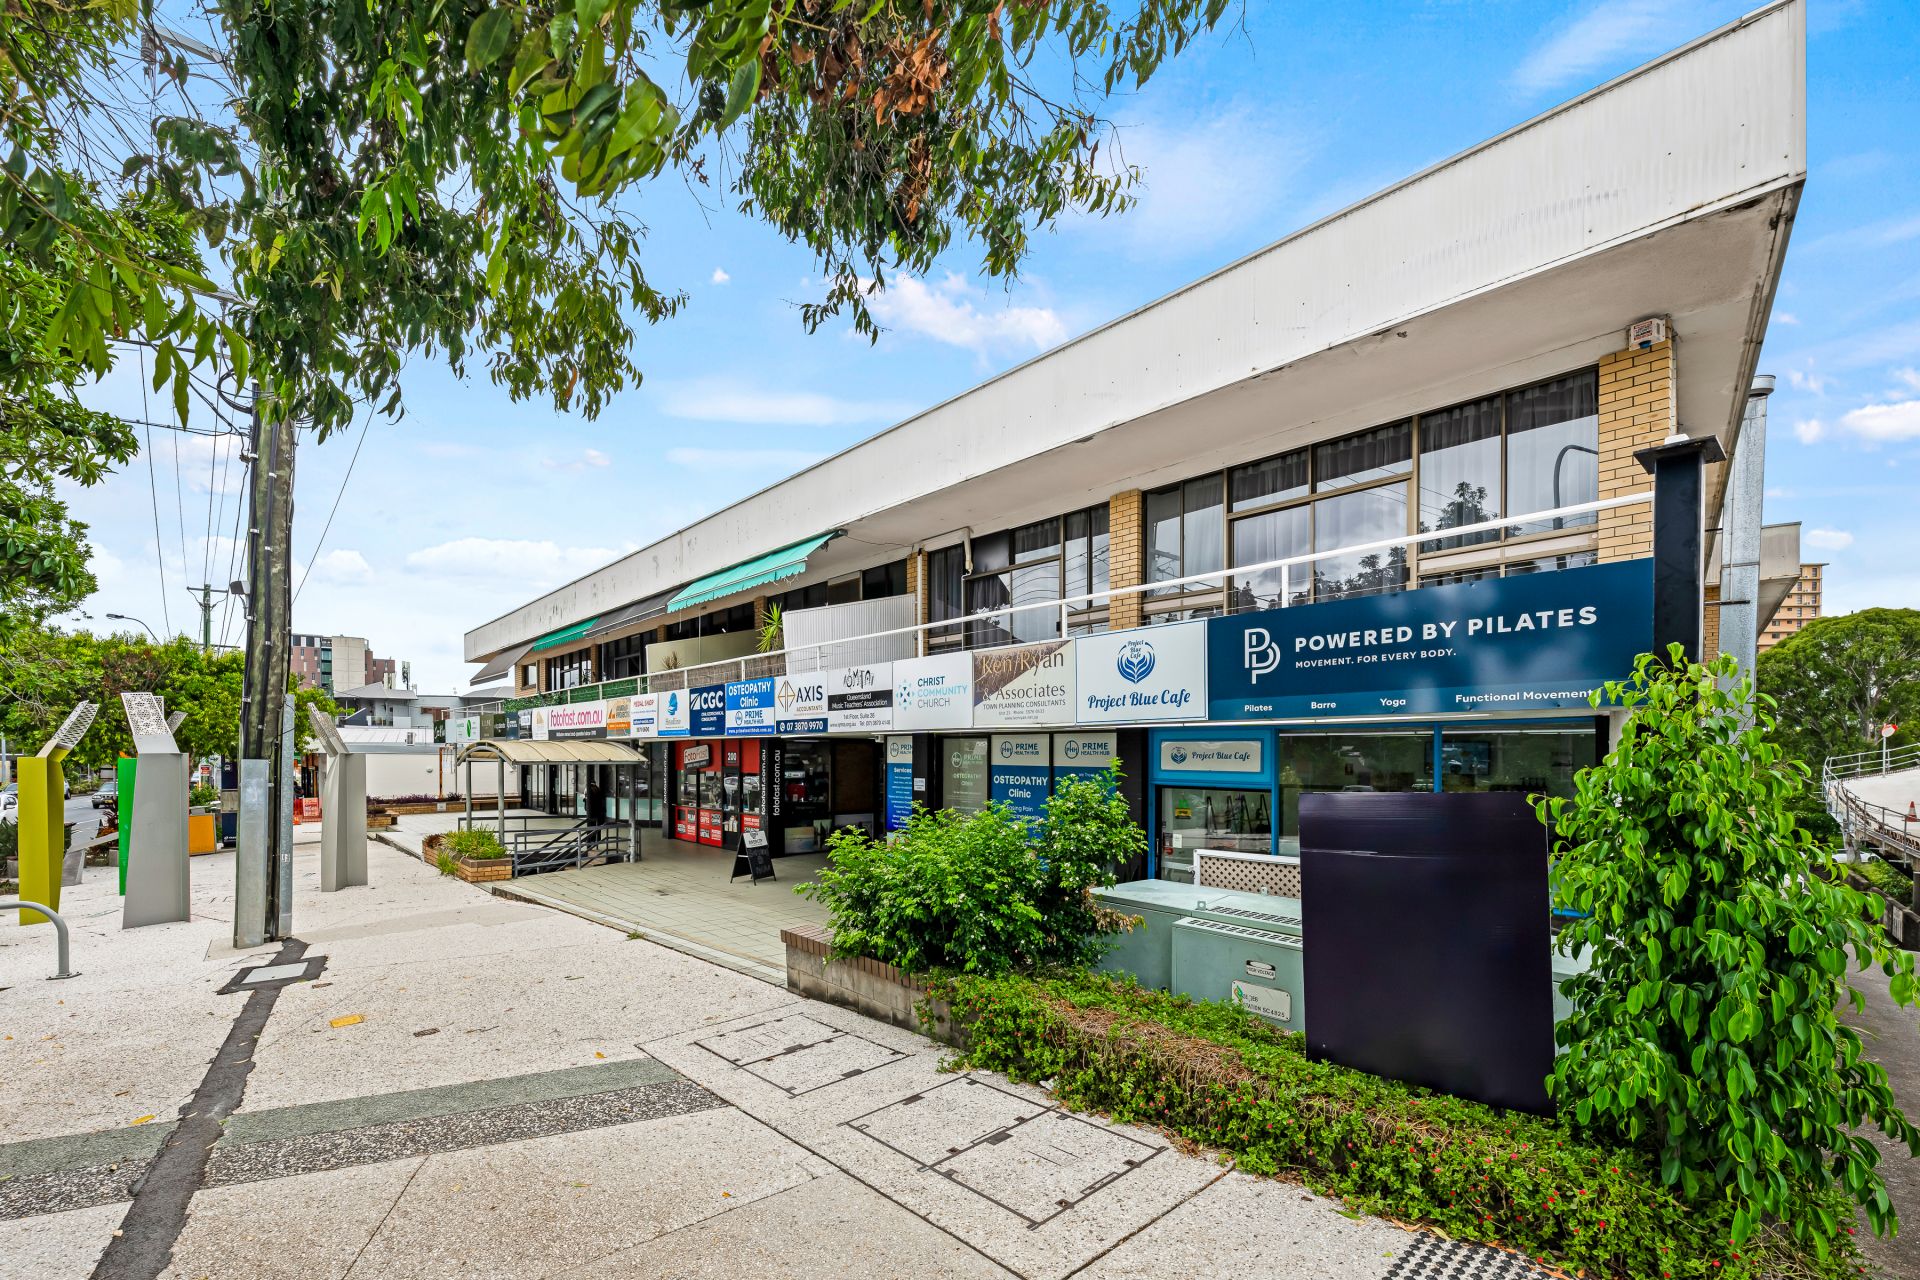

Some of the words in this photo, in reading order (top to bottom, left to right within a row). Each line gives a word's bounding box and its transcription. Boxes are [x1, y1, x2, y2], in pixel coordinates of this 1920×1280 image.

[1295, 627, 1413, 652] POWERED
[1422, 621, 1457, 641] BY
[1468, 606, 1598, 636] PILATES
[1127, 639, 1144, 648] Project
[982, 654, 1012, 675] Ken
[1020, 651, 1064, 676] Ryan
[1295, 656, 1354, 669] MOVEMENT.
[1357, 655, 1378, 664] FOR
[1381, 651, 1417, 662] EVERY
[1420, 648, 1457, 659] BODY.
[917, 675, 946, 687] CHRIST
[728, 681, 772, 696] OSTEOPATHY
[796, 684, 823, 703] AXIS
[917, 685, 968, 698] COMMUNITY
[982, 688, 991, 701] &
[995, 683, 1066, 701] Associates
[701, 691, 724, 709] CGC
[740, 695, 759, 707] Clinic
[846, 692, 872, 700] Queensland
[1087, 693, 1126, 711] Project
[1129, 691, 1159, 706] Blue
[1161, 688, 1191, 708] Cafe
[1455, 691, 1520, 703] Functional
[863, 699, 888, 707] Association
[917, 697, 951, 709] CHURCH
[983, 703, 998, 711] TOWN
[999, 701, 1025, 710] PLANNING
[1025, 699, 1066, 707] CONSULTANTS
[1244, 704, 1273, 712] Pilates
[1310, 701, 1337, 709] Barre
[1380, 698, 1406, 708] Yoga
[550, 708, 603, 727] fotofast.com.au
[744, 710, 763, 719] PRIME
[786, 722, 794, 731] 07
[808, 720, 823, 730] 9970
[1015, 743, 1038, 751] PRIME
[1082, 742, 1109, 750] PRIME
[1191, 751, 1215, 760] Project
[1216, 751, 1232, 760] Blue
[1234, 751, 1251, 761] Cafe
[772, 749, 781, 816] fotofast.com.au
[993, 775, 1048, 786] OSTEOPATHY
[1008, 788, 1032, 798] Clinic
